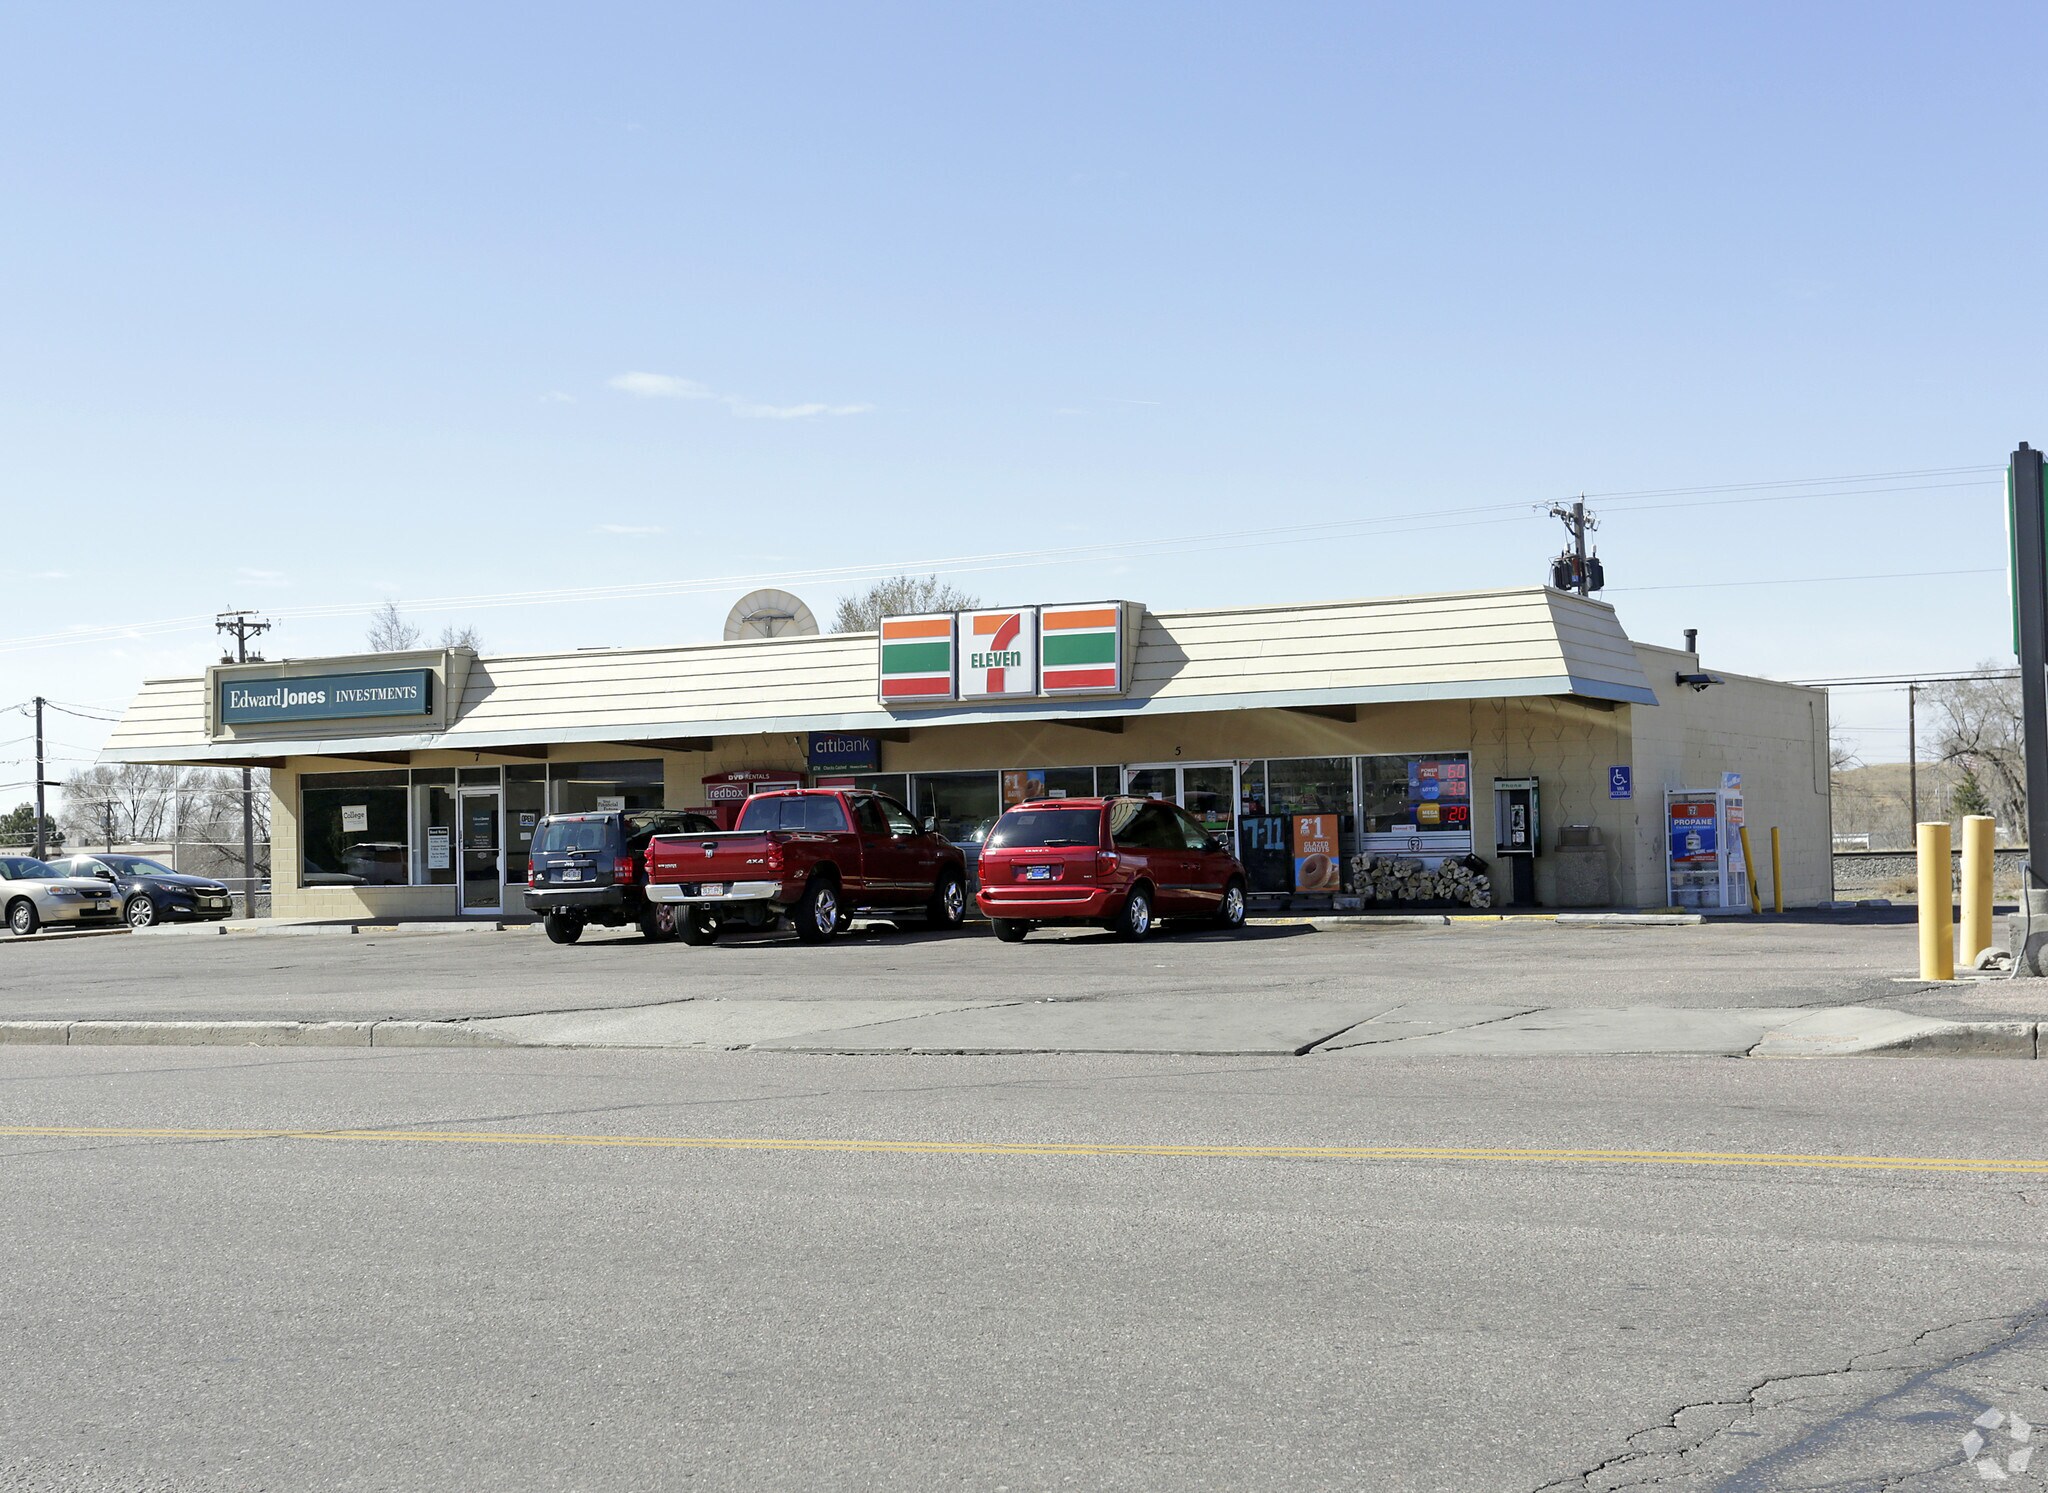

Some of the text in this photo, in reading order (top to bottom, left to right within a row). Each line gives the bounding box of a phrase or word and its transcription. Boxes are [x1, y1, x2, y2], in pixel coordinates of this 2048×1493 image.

[973, 613, 1020, 693] 7
[336, 685, 417, 703] INVESTMENTS
[815, 737, 870, 753] citibank
[1175, 746, 1181, 756] 5
[1448, 764, 1466, 779] 60
[710, 788, 744, 798] redbox
[343, 811, 365, 820] College
[1449, 806, 1467, 820] 20
[1674, 818, 1713, 826] PROPANE
[1242, 817, 1285, 850] 7-11
